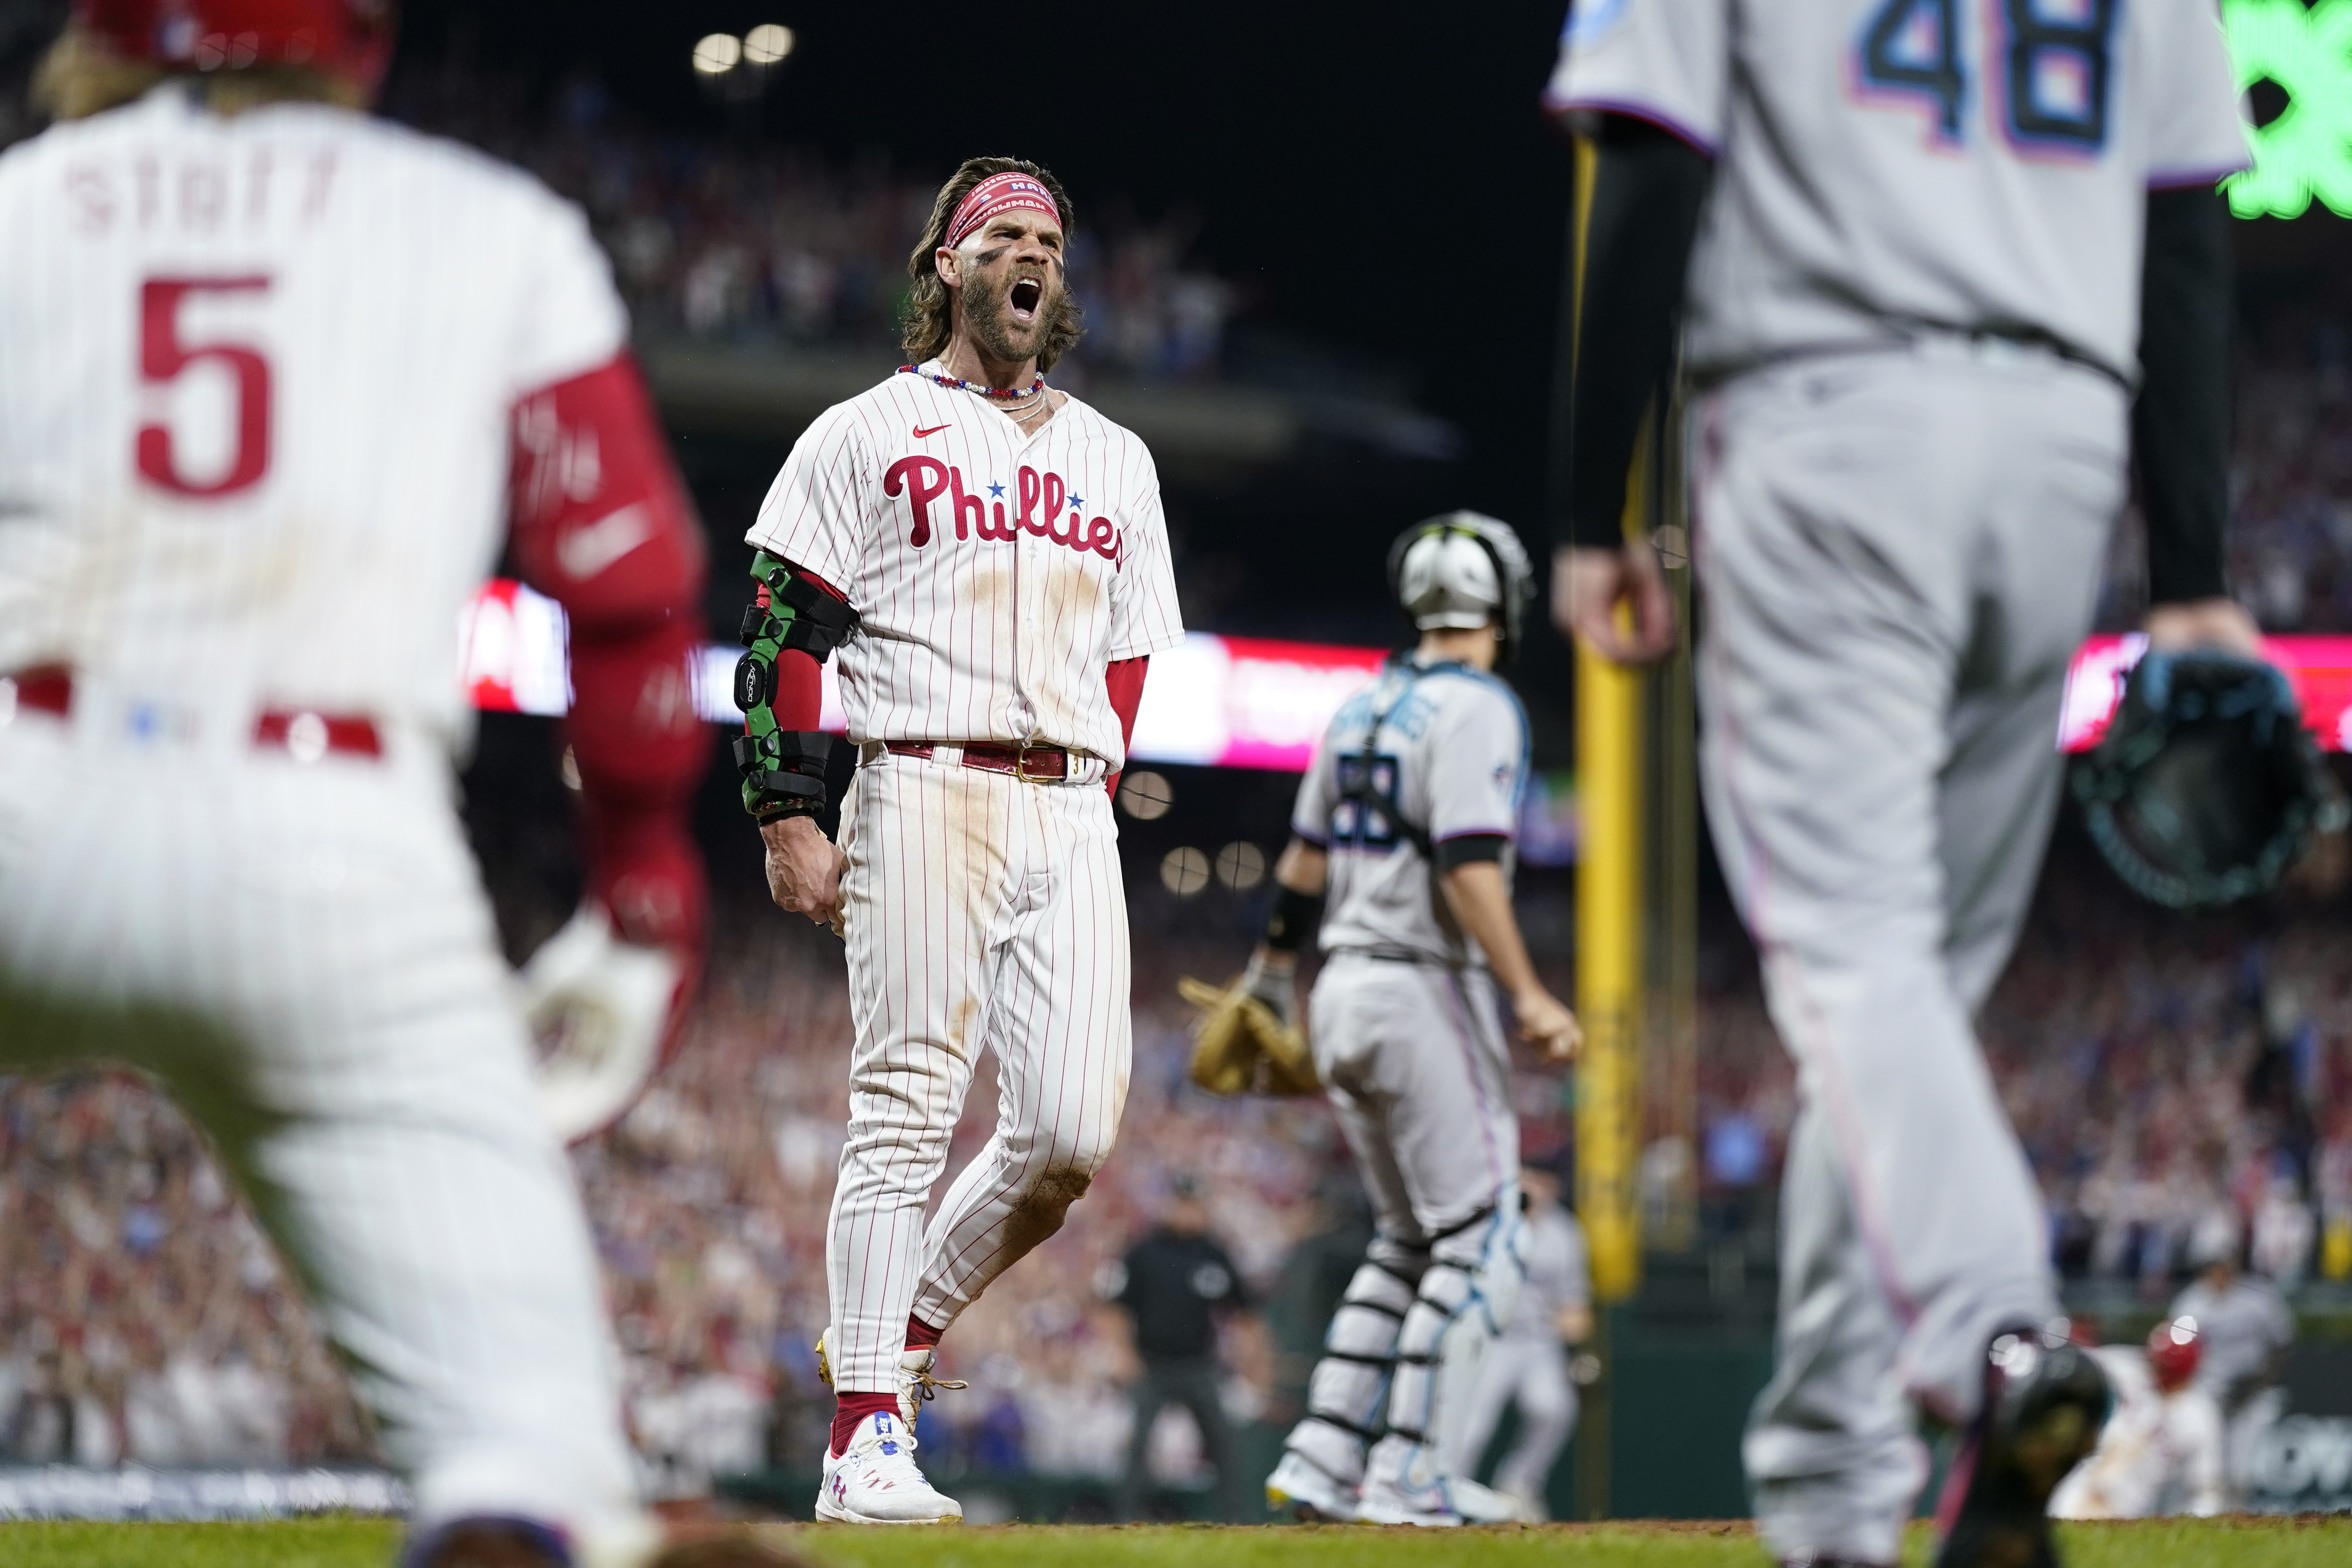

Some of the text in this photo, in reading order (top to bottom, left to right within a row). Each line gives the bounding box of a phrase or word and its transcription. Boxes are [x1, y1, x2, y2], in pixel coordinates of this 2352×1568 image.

[1843, 0, 2110, 171] 48
[132, 271, 277, 504] 5
[1073, 755, 1078, 774] 3
